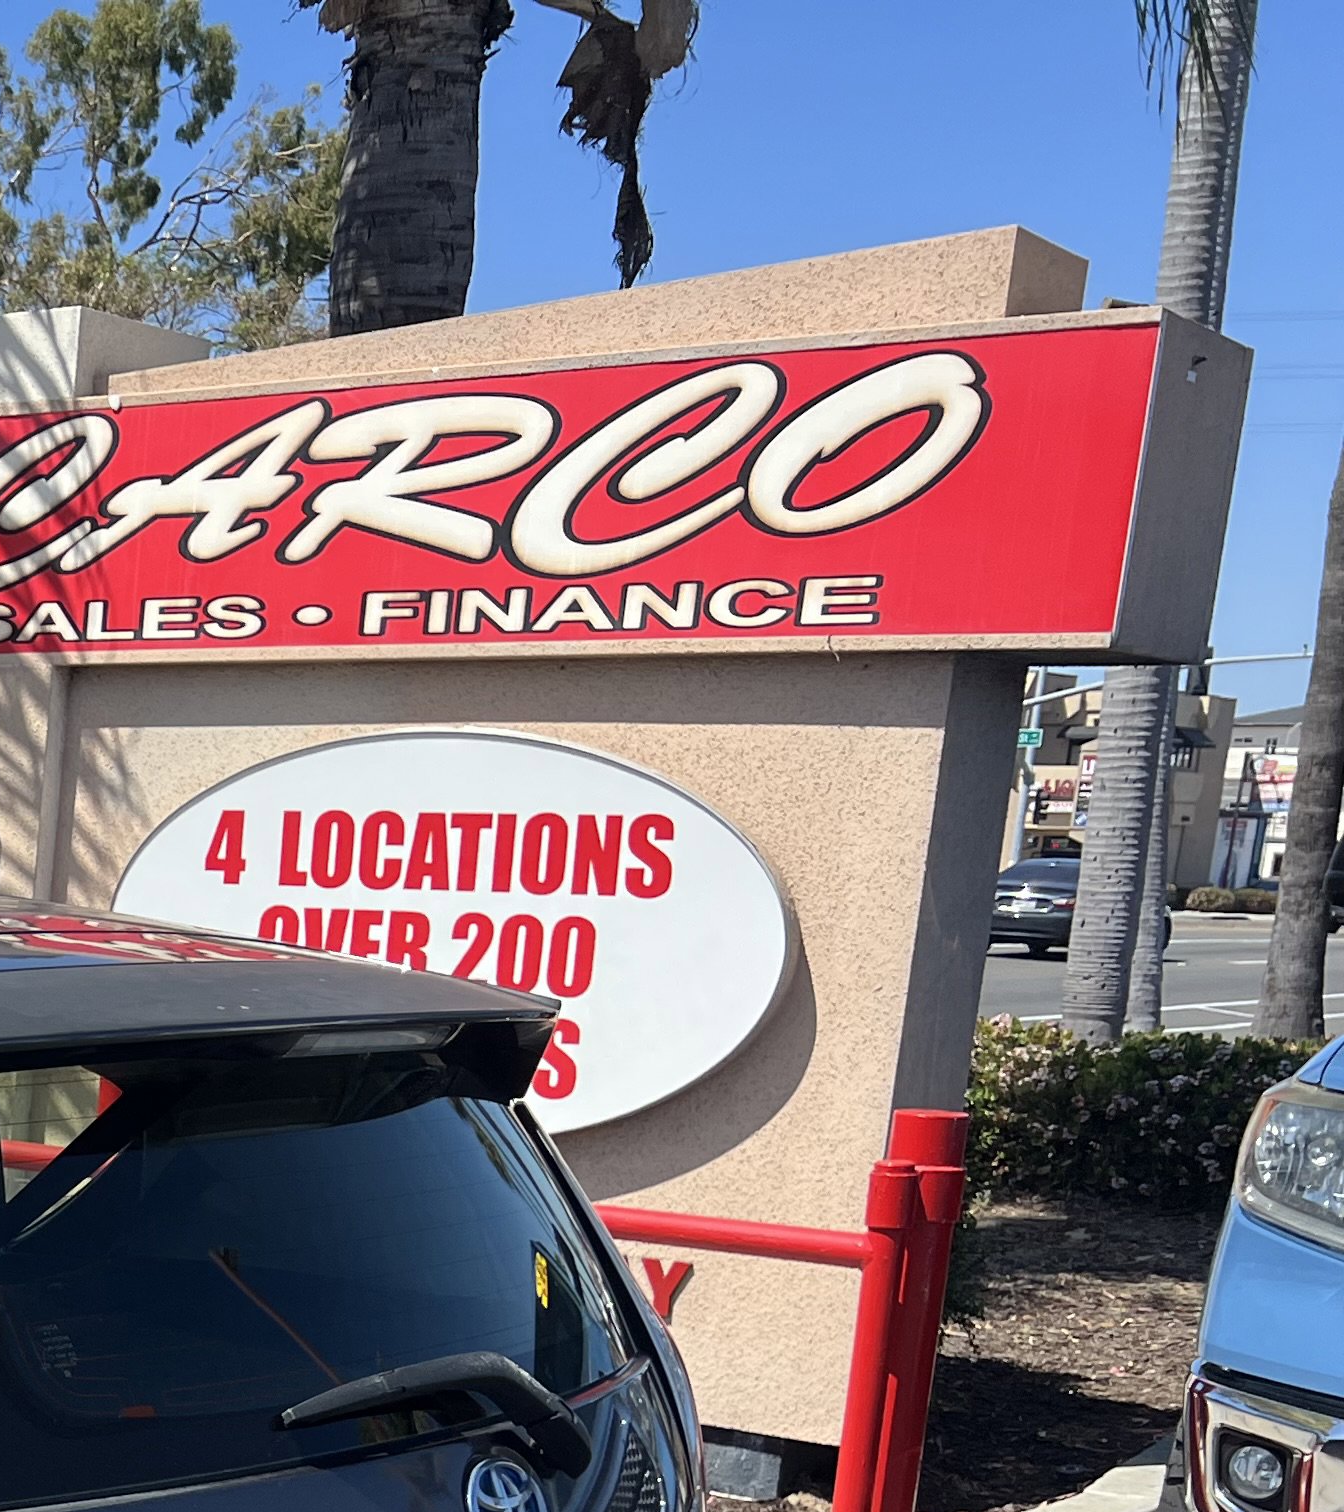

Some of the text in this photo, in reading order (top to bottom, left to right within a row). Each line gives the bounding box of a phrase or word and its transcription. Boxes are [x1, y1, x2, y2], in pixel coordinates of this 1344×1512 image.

[360, 575, 883, 636] FINANCE
[204, 810, 675, 898] 4 LOCATIONS
[452, 912, 596, 998] 200
